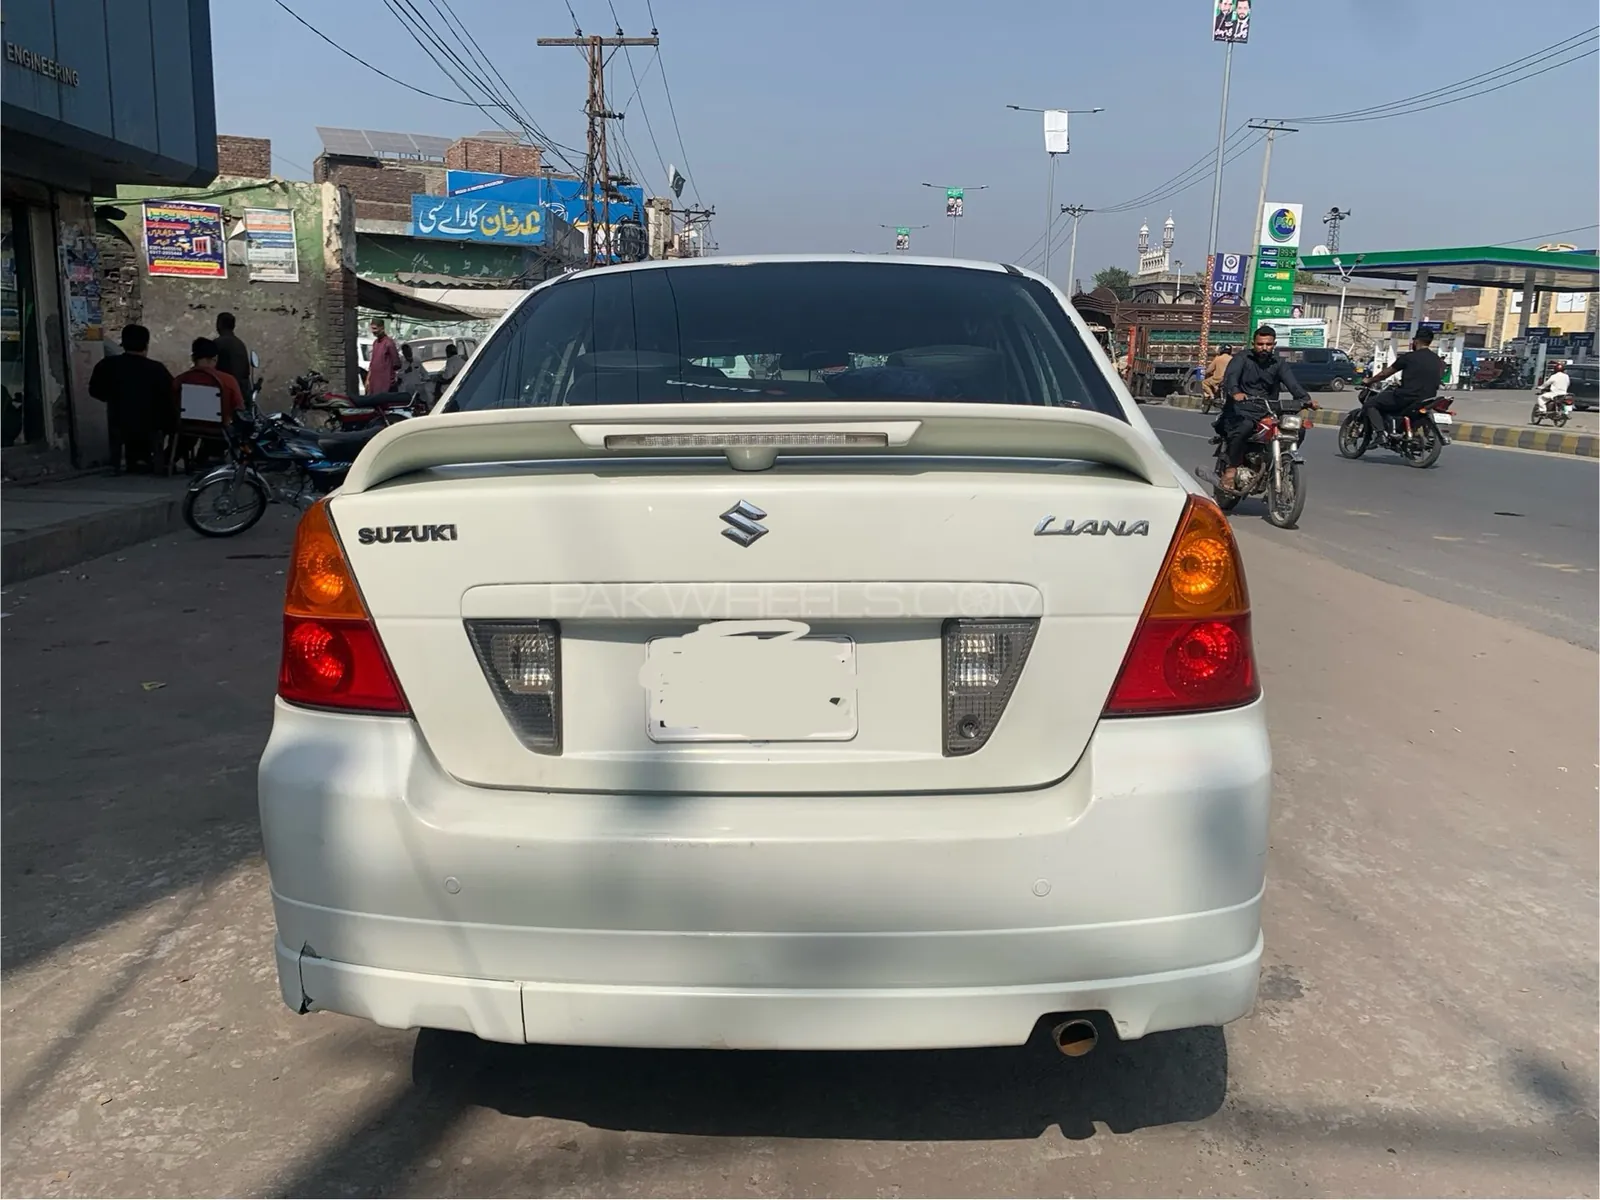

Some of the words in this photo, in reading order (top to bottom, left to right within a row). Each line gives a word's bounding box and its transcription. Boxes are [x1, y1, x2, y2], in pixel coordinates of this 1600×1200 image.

[6, 41, 80, 87] ENGINEERING
[480, 205, 541, 237] عدنان
[1276, 216, 1294, 228] PSO
[1214, 281, 1242, 293] GIFT
[357, 523, 458, 545] SUZUKI
[1033, 514, 1149, 536] LIANA
